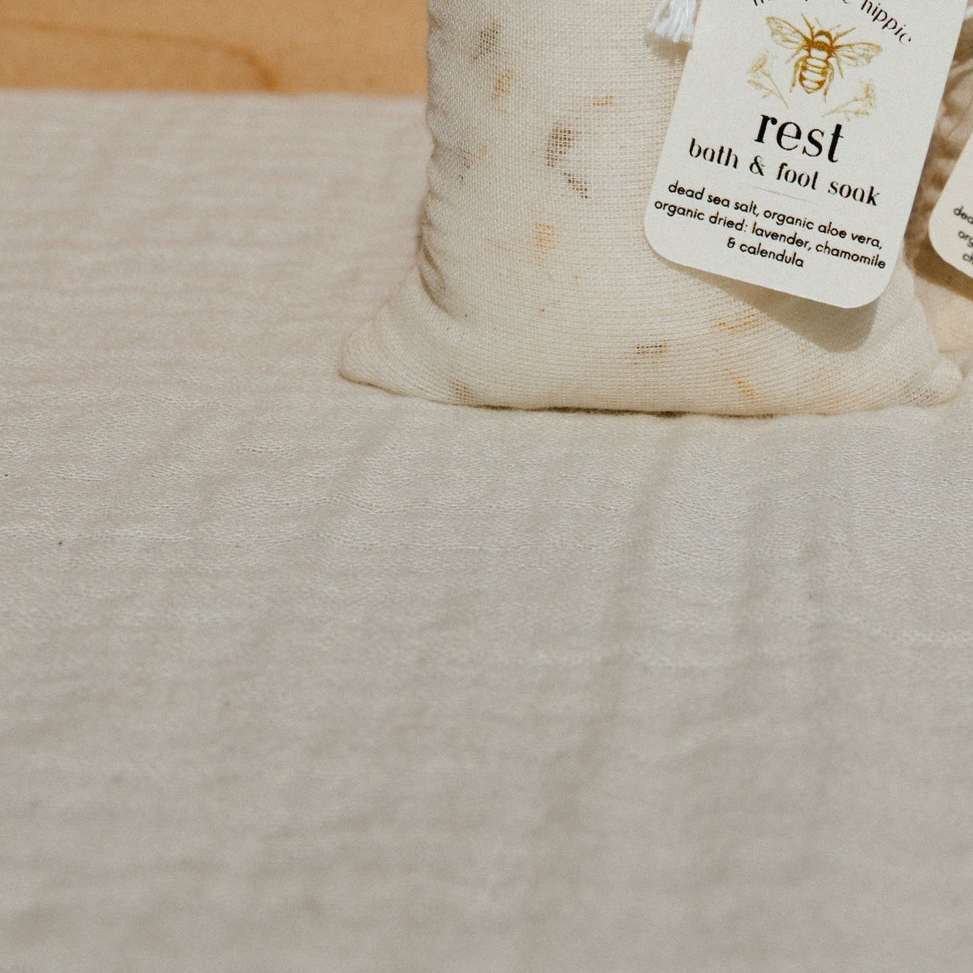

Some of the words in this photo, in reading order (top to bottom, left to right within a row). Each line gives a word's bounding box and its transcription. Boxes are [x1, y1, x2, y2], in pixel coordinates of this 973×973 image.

[689, 138, 738, 169] bath
[749, 155, 765, 176] &
[776, 162, 819, 190] foot
[828, 180, 880, 206] soak
[754, 114, 844, 163] rest
[654, 200, 705, 221] organic
[709, 212, 749, 232] dried:
[751, 222, 812, 251] lavender,
[815, 242, 886, 269] chamomile
[668, 180, 705, 200] dead
[707, 191, 730, 207] sea
[734, 200, 760, 217] salt,
[763, 208, 815, 230] organic
[817, 222, 847, 239] aloe
[851, 233, 884, 250] vera,
[727, 237, 736, 249] &
[739, 242, 804, 268] calendula
